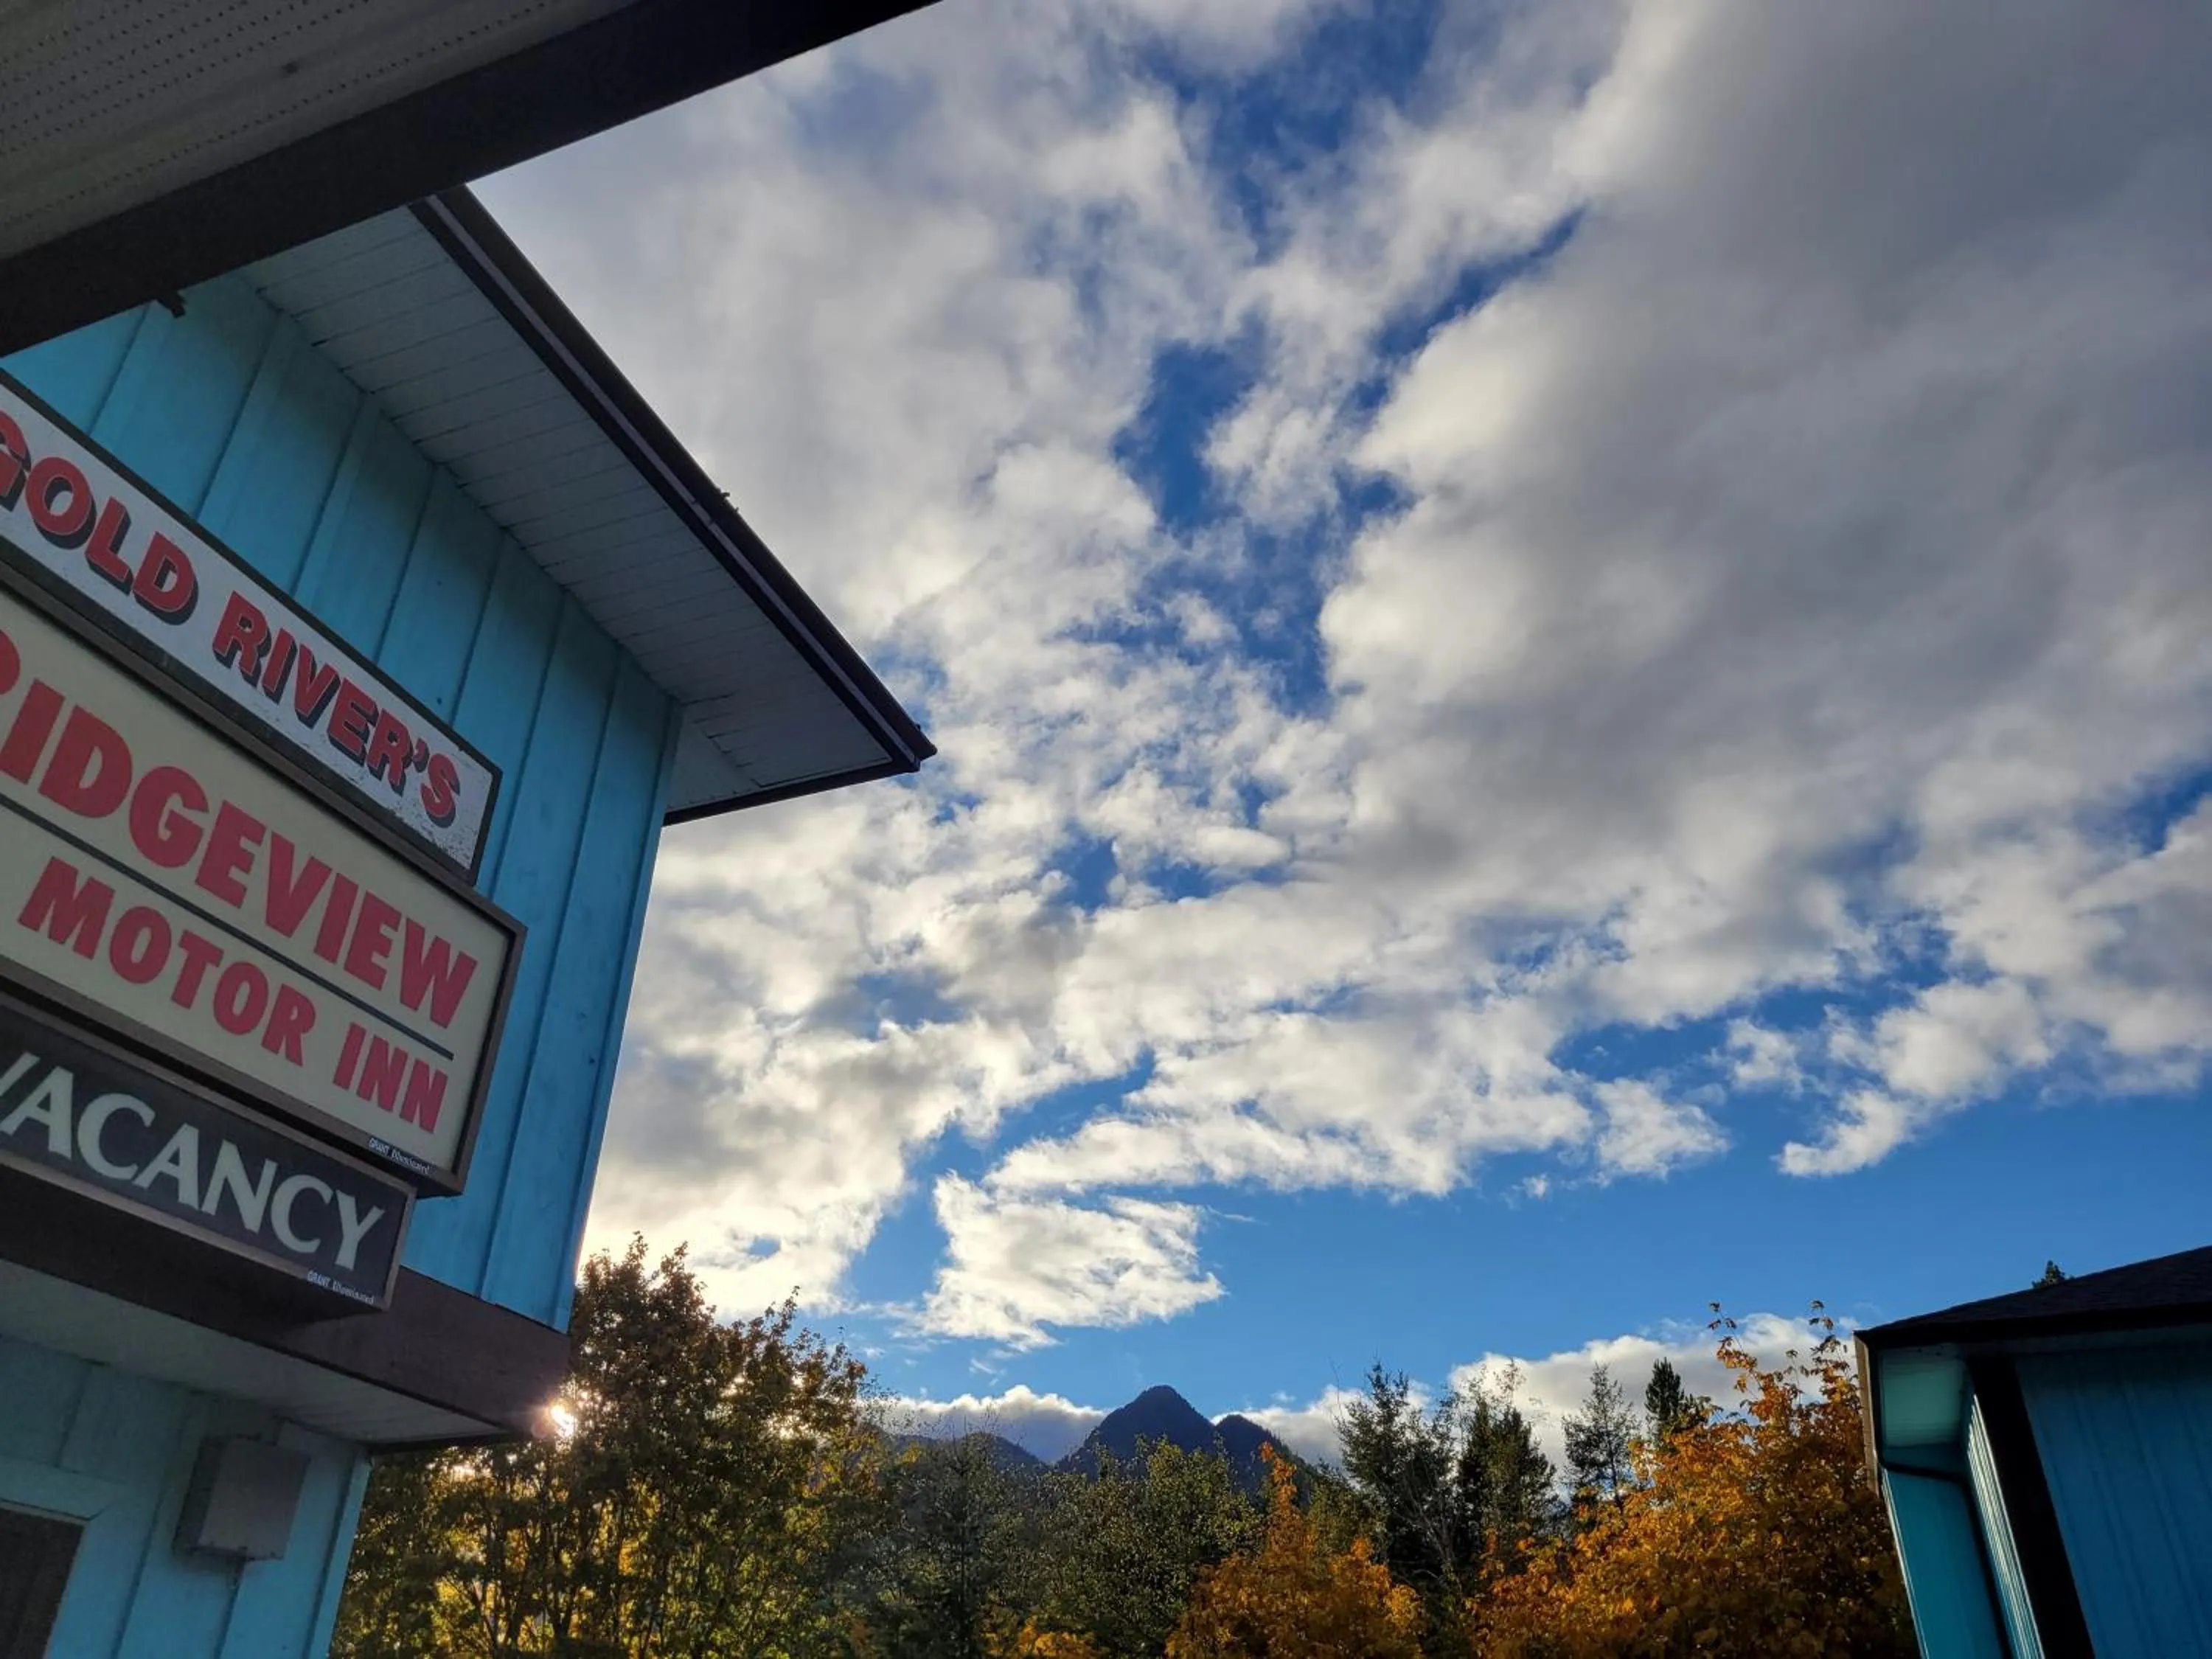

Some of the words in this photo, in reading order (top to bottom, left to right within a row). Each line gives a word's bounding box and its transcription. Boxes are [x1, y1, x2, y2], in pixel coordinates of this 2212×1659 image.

[0, 628, 478, 1029] IDGEVIEW
[212, 591, 460, 827] RIVER'S
[18, 856, 317, 1066] MOTOR
[333, 1023, 448, 1134] INN
